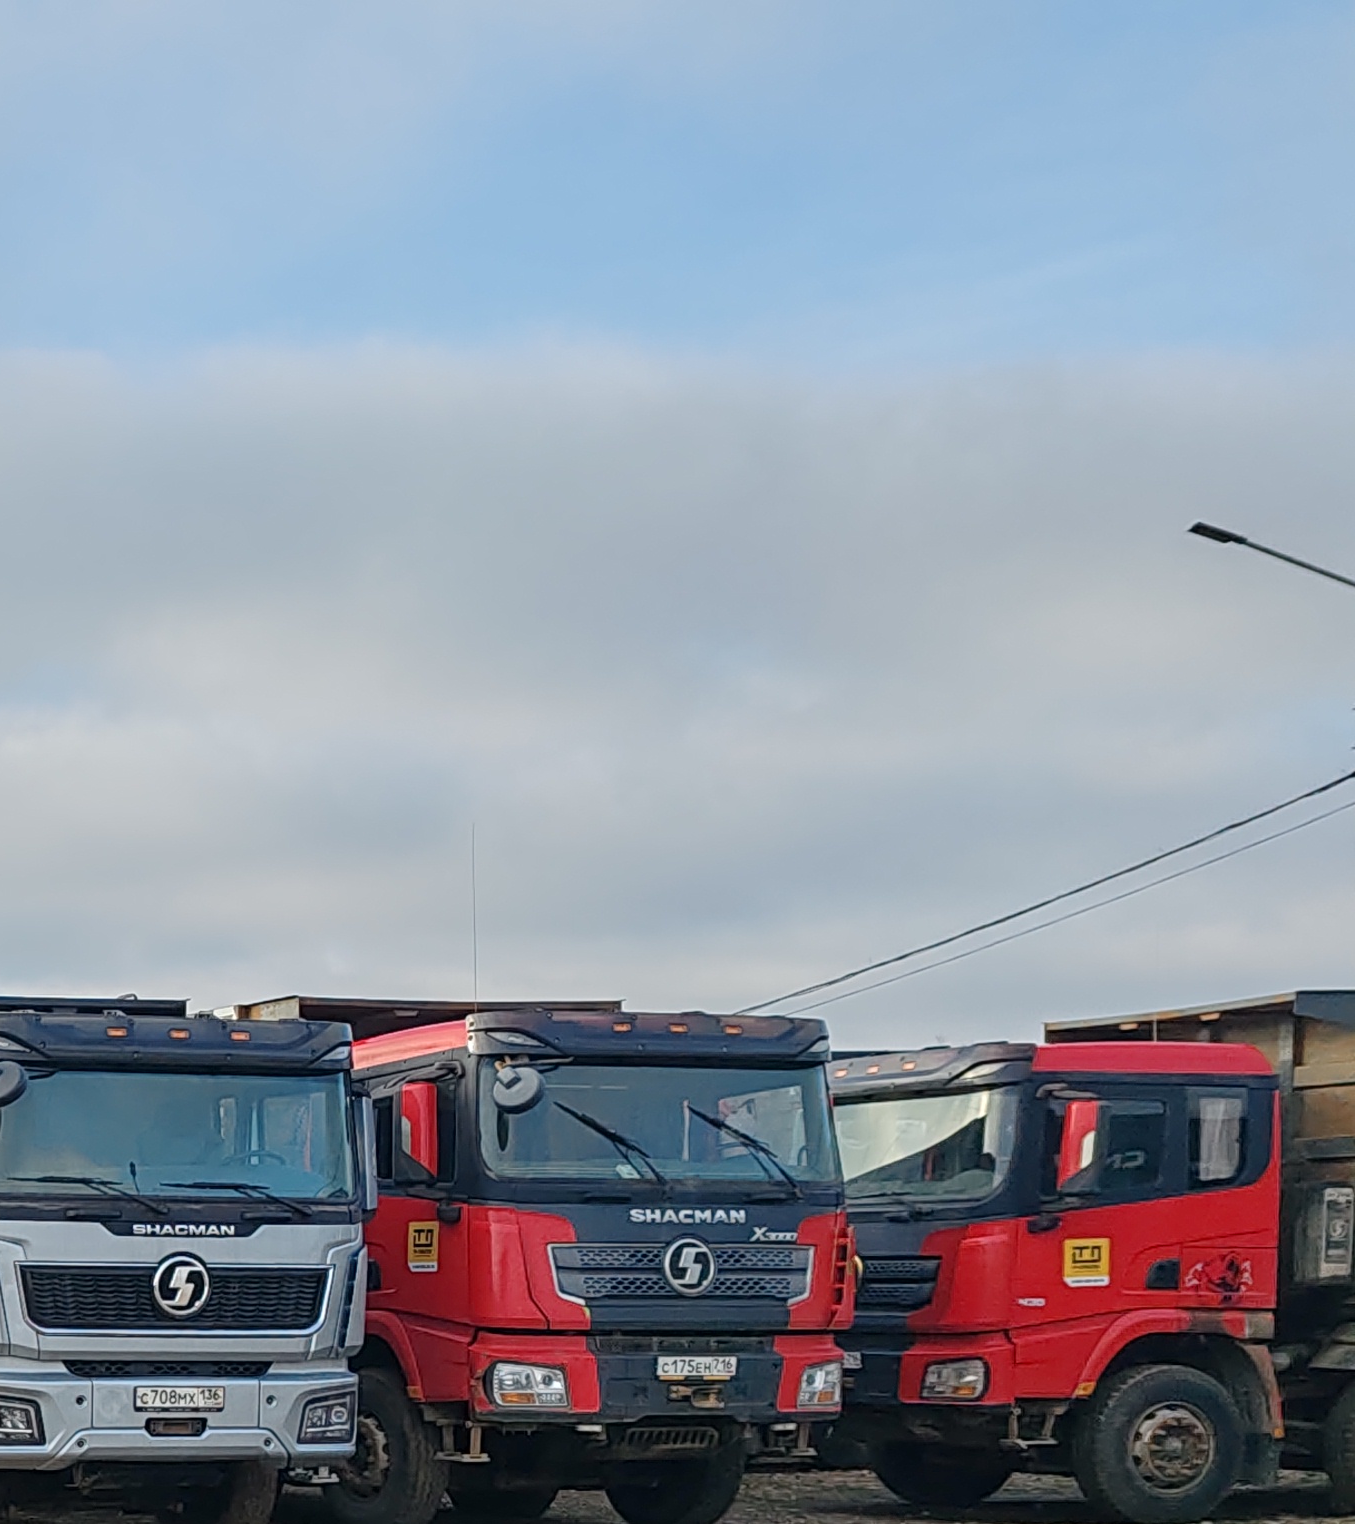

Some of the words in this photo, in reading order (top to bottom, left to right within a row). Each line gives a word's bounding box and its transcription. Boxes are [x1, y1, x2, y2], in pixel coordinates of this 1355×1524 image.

[629, 1208, 746, 1224] SHACMAN
[132, 1223, 235, 1236] SHACMAN
[661, 1359, 712, 1374] С175ЕН
[712, 1357, 733, 1370] 716
[140, 1389, 196, 1405] С708МХ
[199, 1388, 221, 1401] 136
